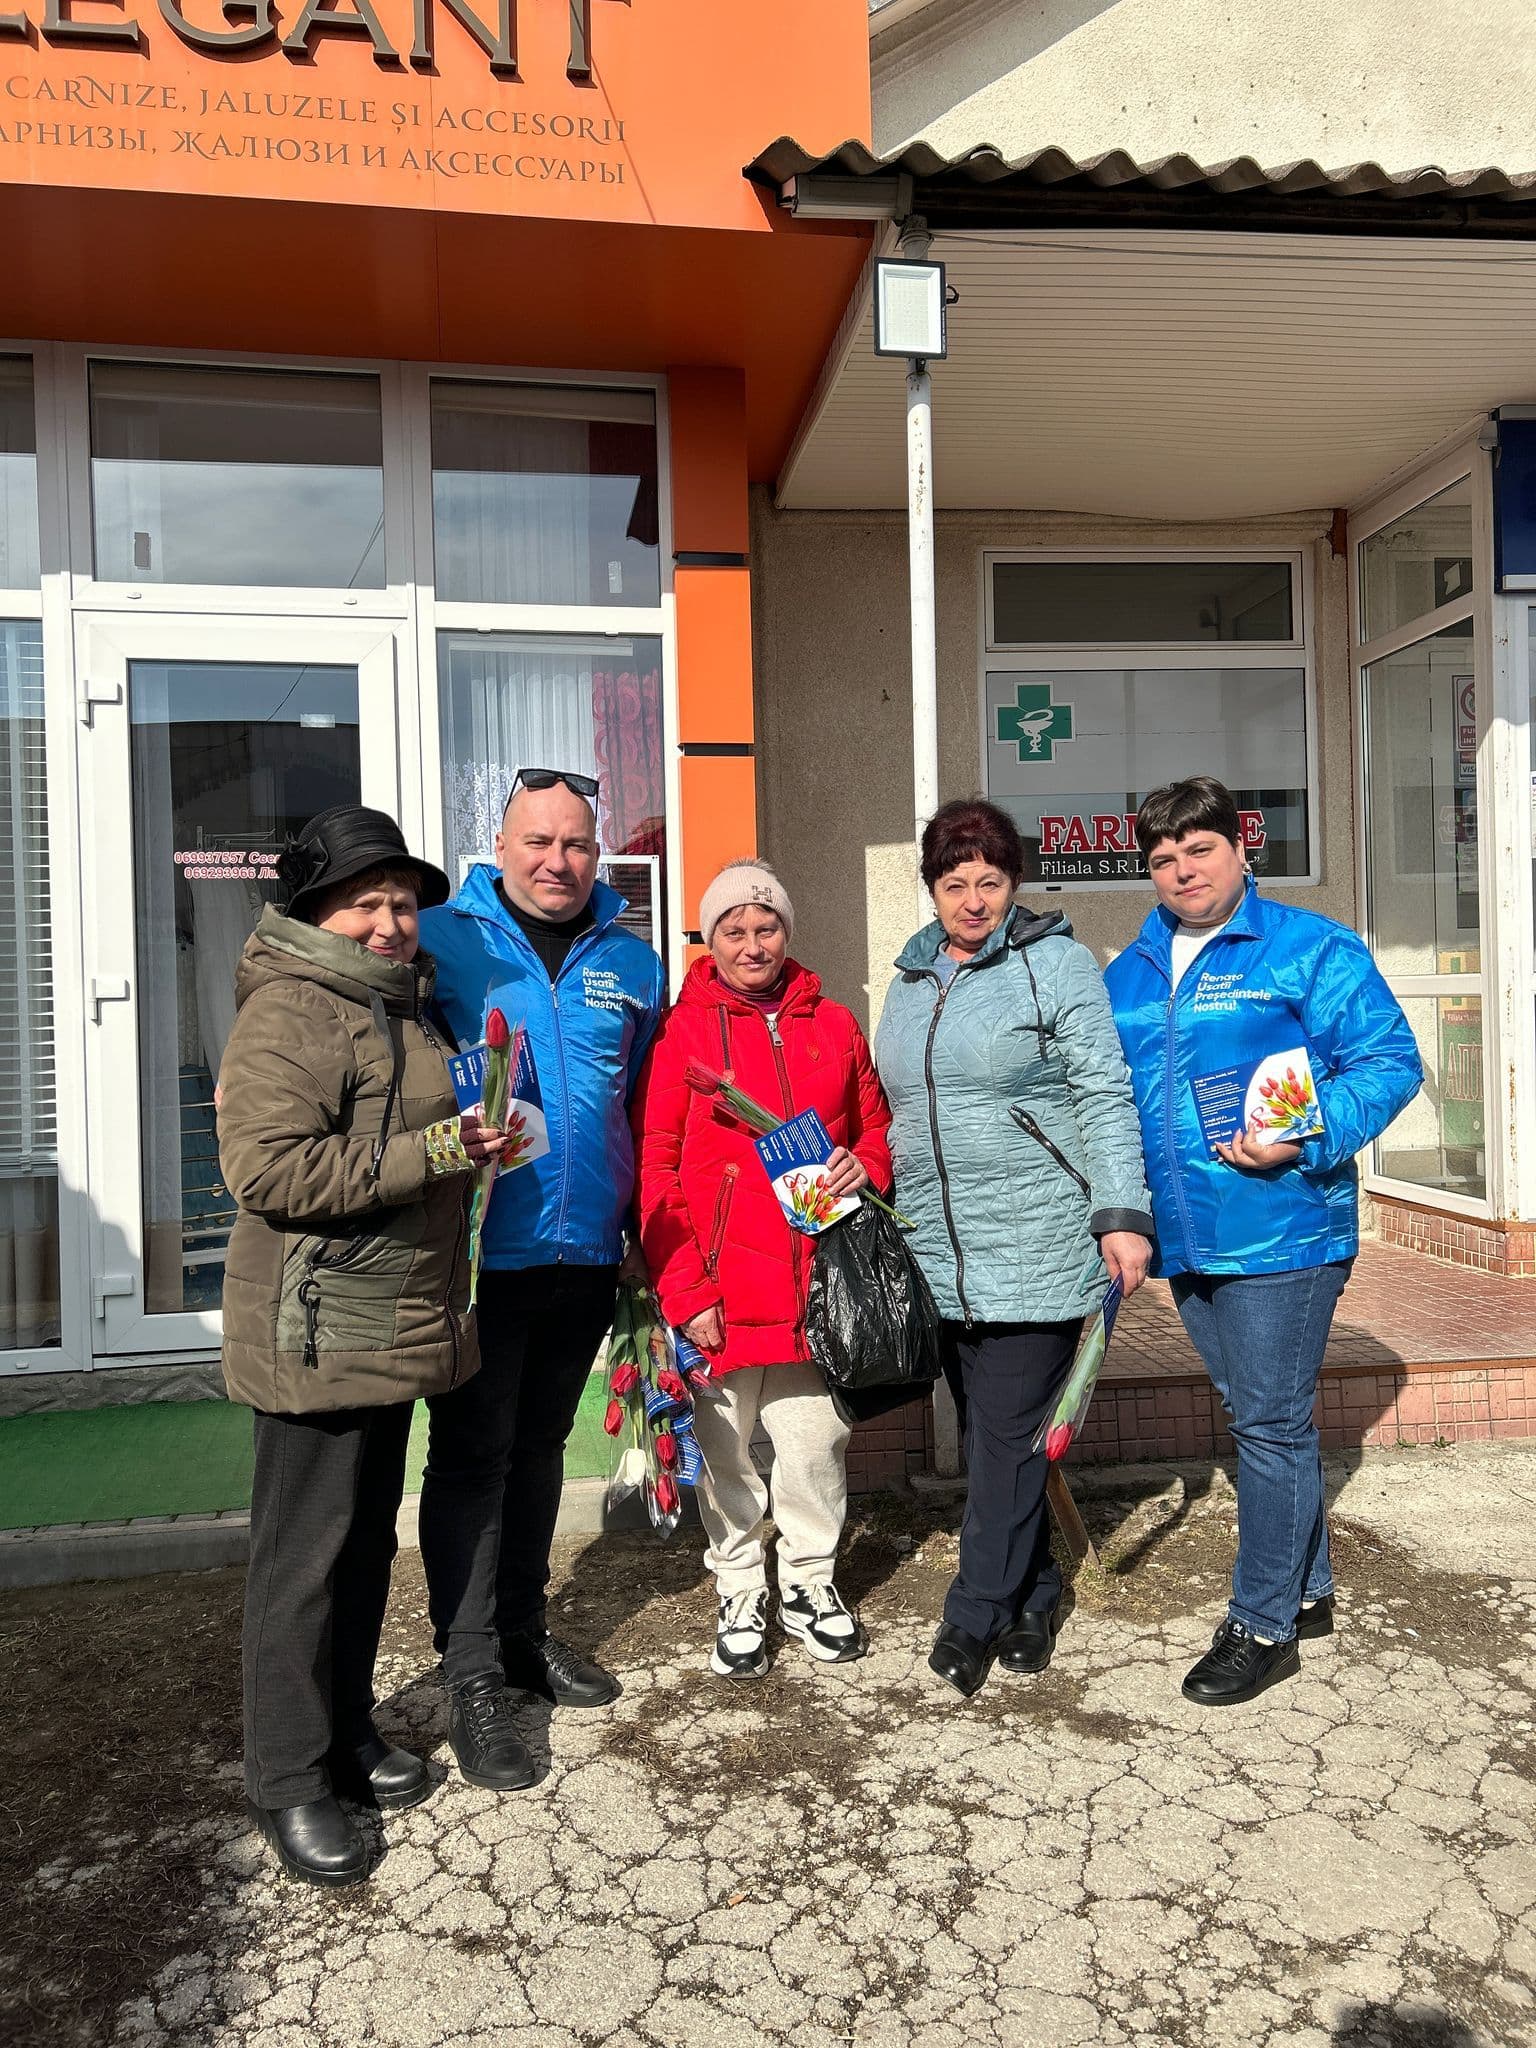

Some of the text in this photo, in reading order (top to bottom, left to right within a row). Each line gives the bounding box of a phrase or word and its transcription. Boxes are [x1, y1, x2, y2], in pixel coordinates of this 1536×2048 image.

[5, 75, 187, 113] CARNIZE,
[199, 88, 377, 123] JALUZELE
[434, 106, 625, 146] ACCESORII
[170, 130, 350, 166] ЖАЛЮЗИ
[362, 144, 387, 169] И
[399, 148, 625, 185] АКСЕССУАРЫ
[1462, 765, 1476, 774] VIS
[174, 851, 246, 864] 069937557
[184, 866, 256, 879] 069293966
[1040, 860, 1093, 875] Filiala
[1200, 972, 1244, 982] Renato
